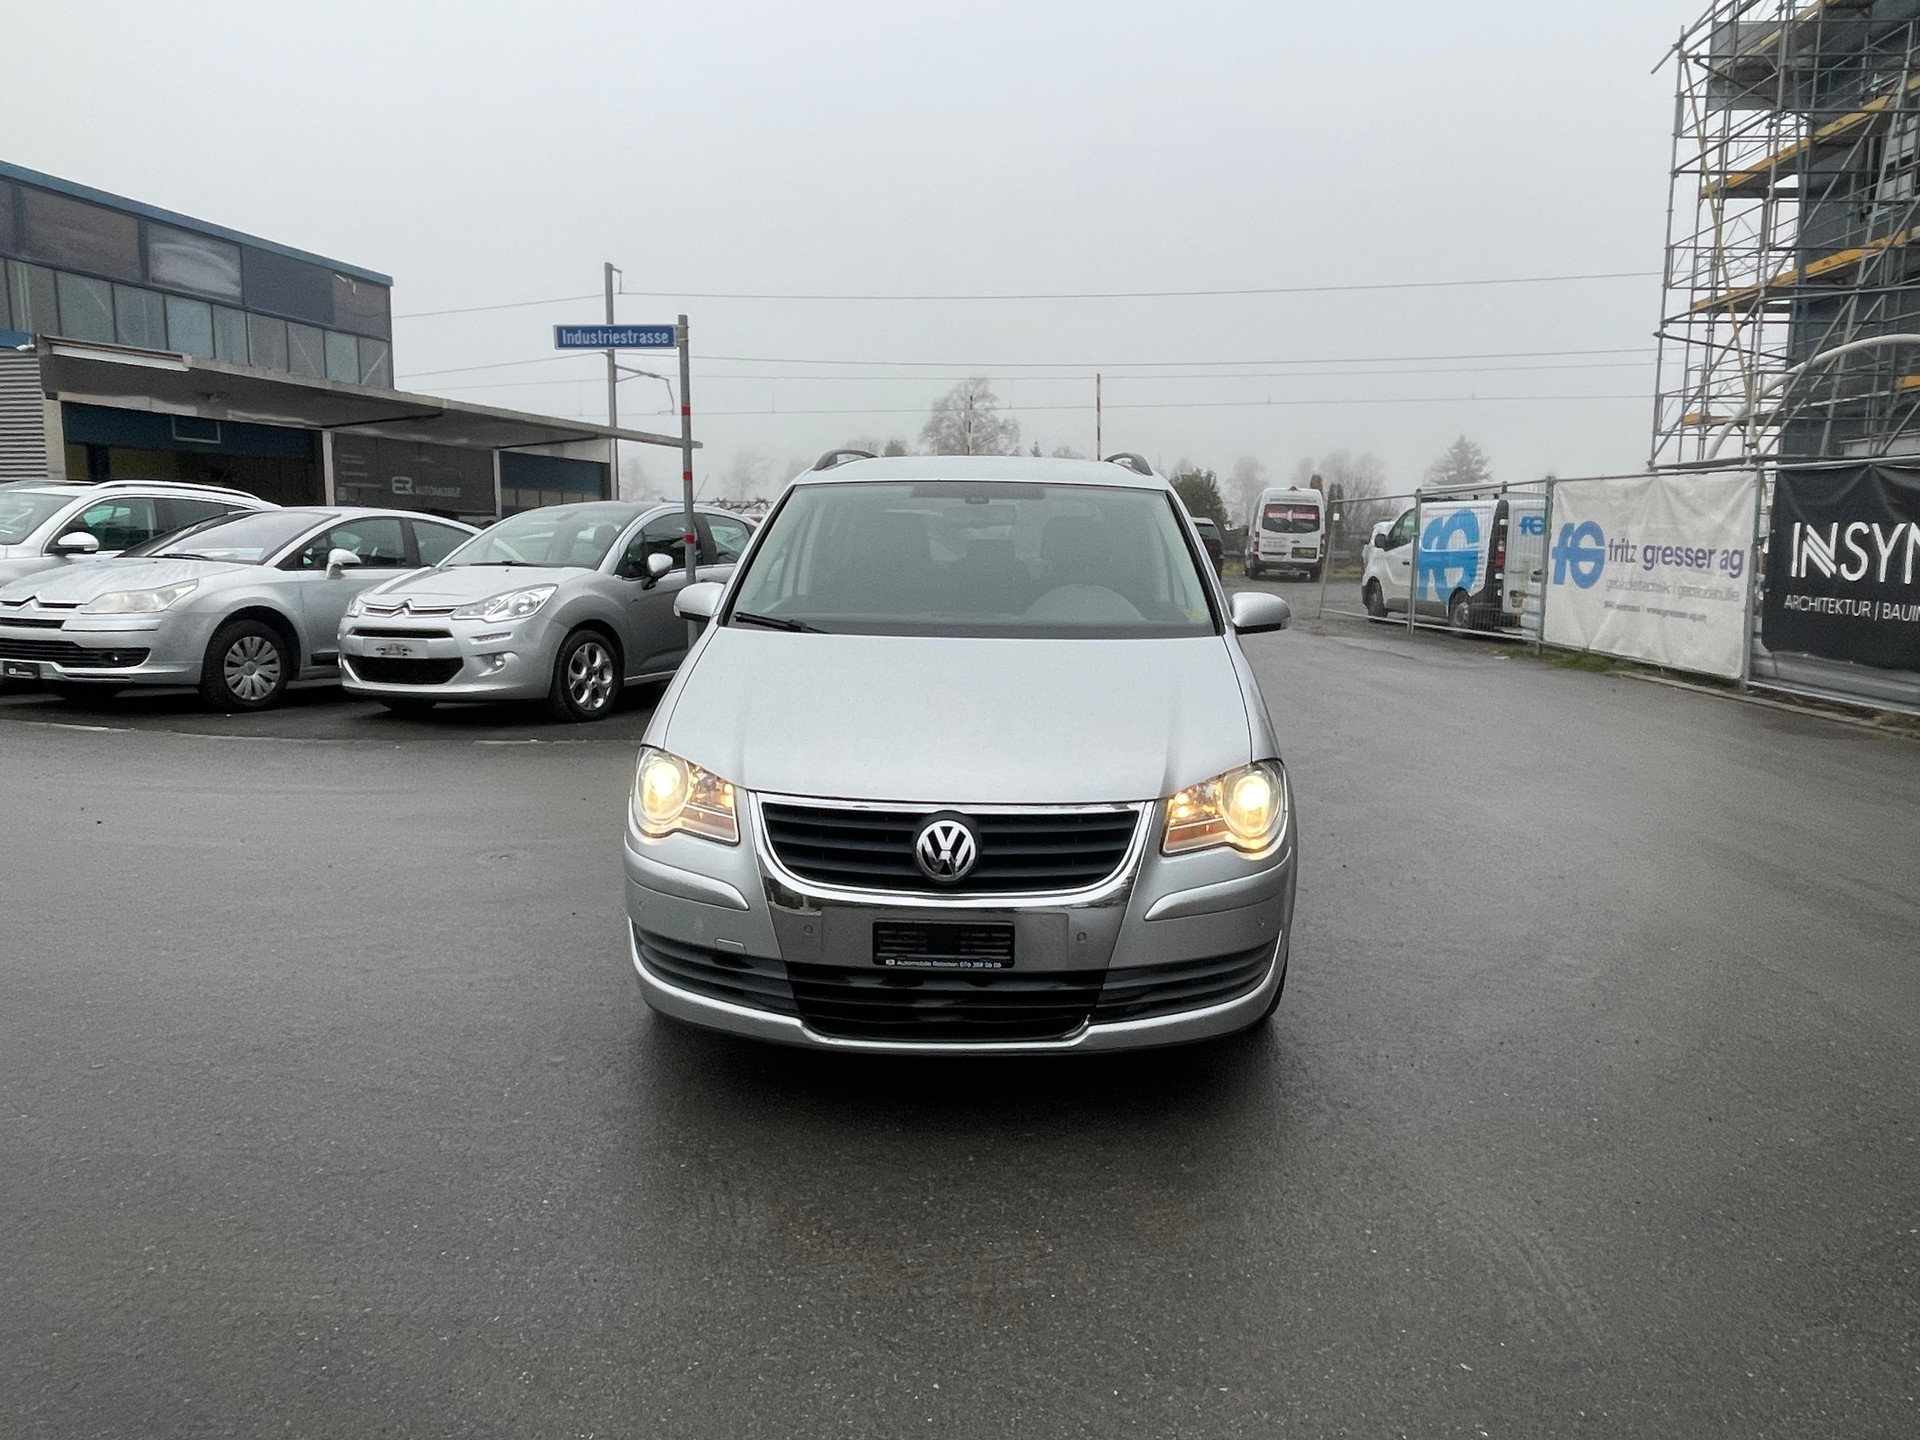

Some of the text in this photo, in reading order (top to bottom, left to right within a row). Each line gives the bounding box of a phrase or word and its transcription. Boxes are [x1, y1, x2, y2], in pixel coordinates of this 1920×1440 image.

[562, 329, 669, 345] Industriestrasse
[1608, 537, 1745, 579] fritz gresser ag
[1783, 595, 1871, 618] ARCHITEKTUR
